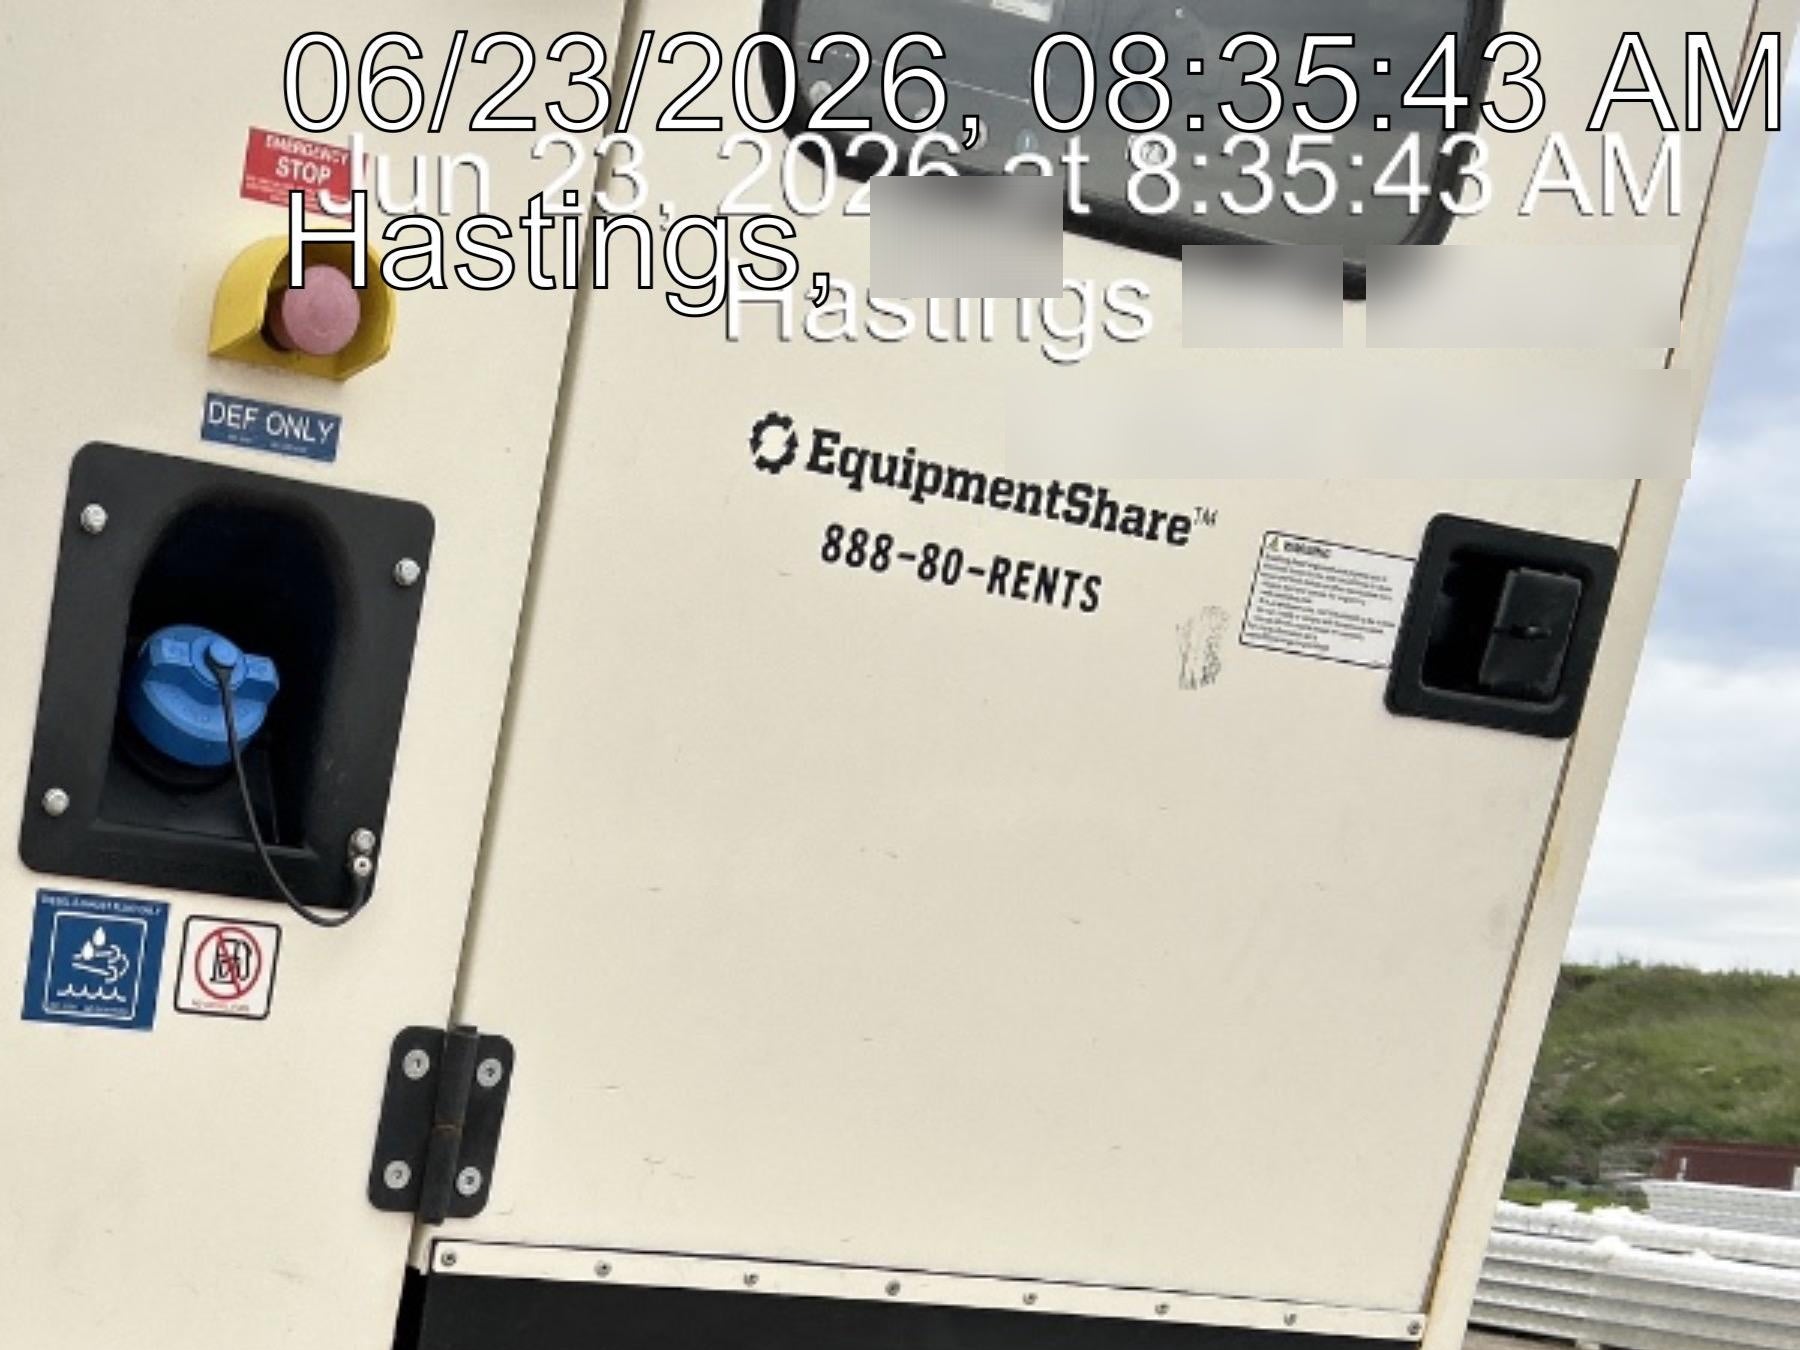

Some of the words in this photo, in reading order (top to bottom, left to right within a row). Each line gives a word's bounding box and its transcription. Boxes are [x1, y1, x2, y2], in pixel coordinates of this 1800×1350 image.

[275, 155, 332, 186] STOP
[207, 400, 260, 431] DEF
[265, 409, 335, 445] ONLY
[804, 426, 1192, 548] EquipmentShare
[820, 522, 1103, 614] 888-80-RENTS
